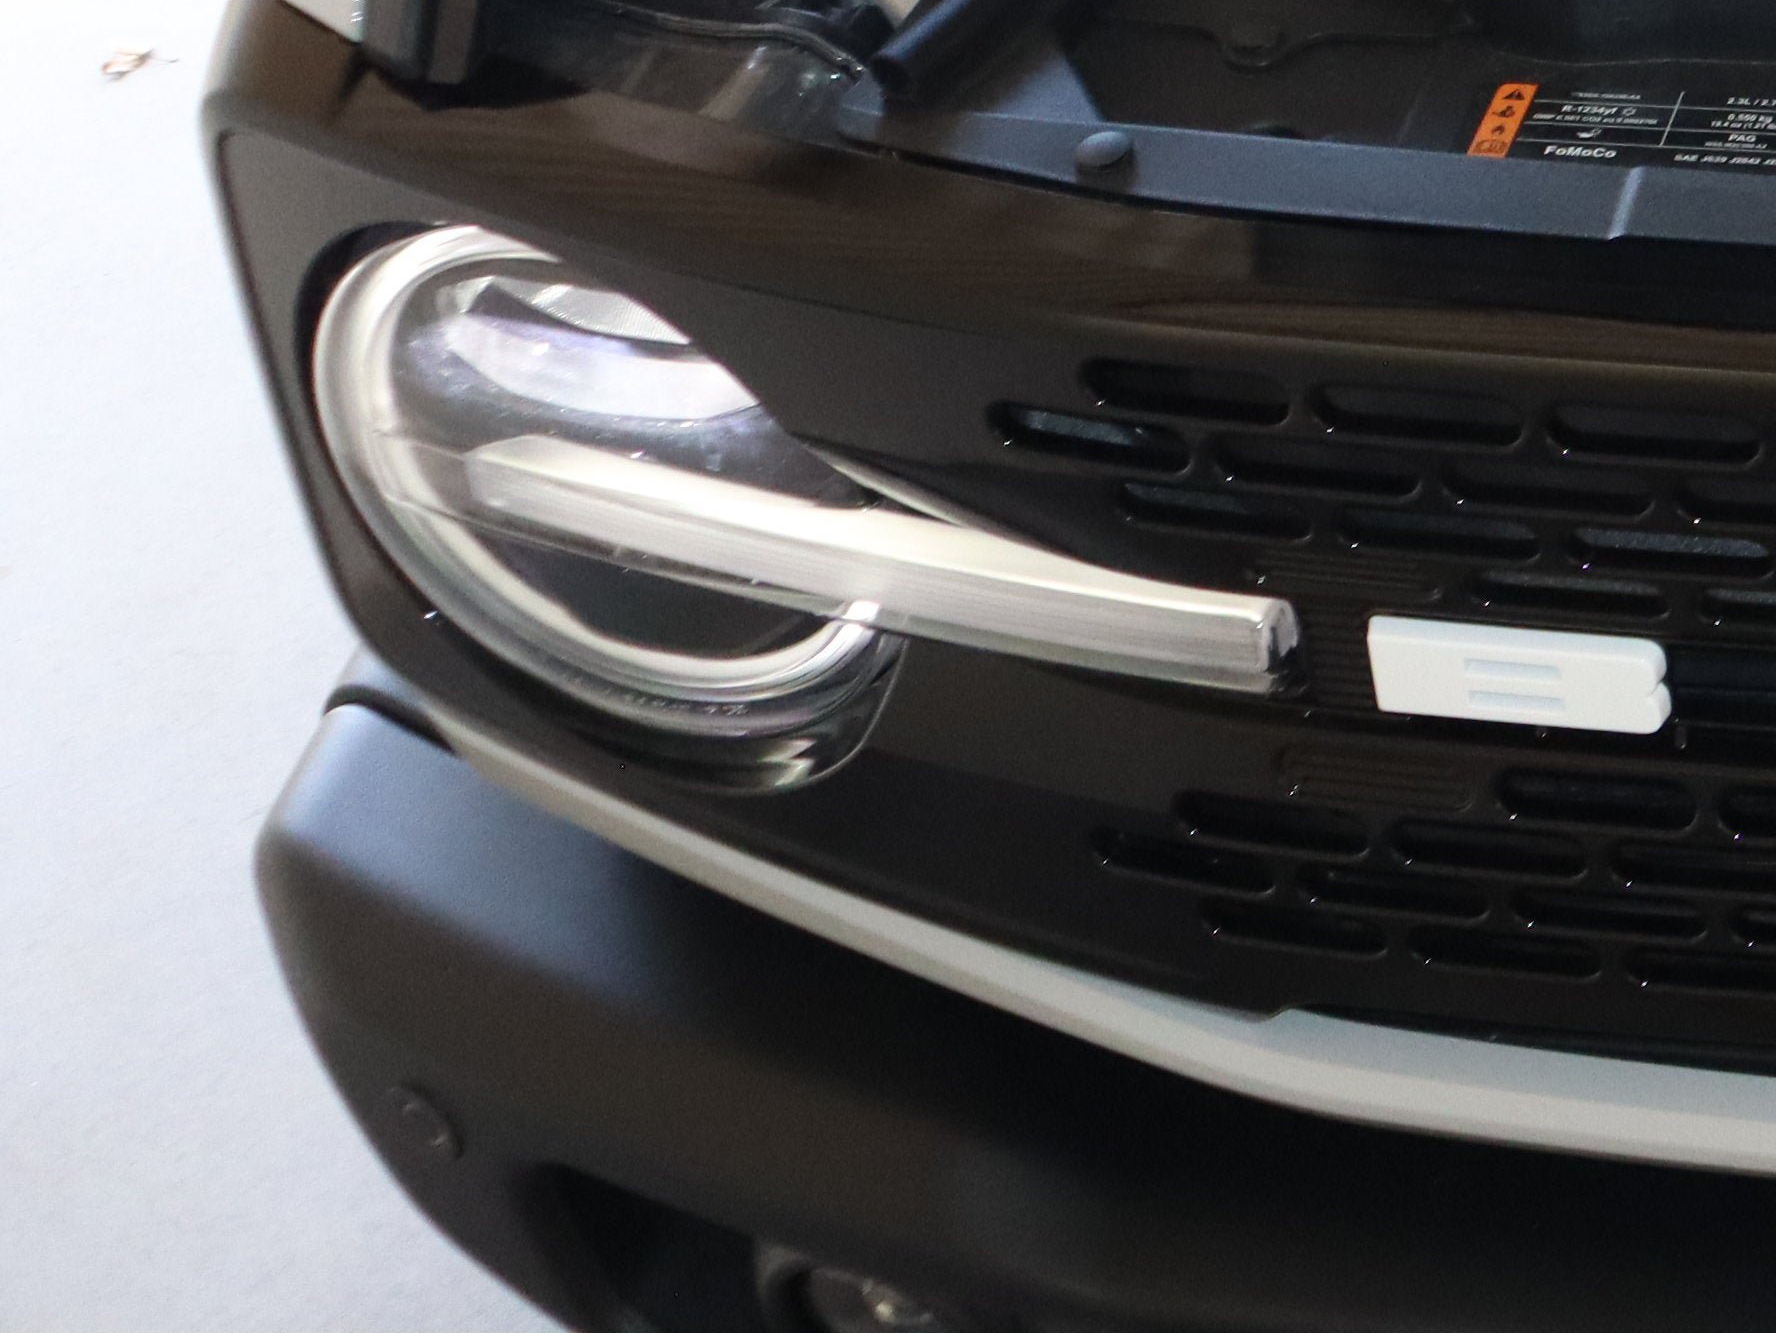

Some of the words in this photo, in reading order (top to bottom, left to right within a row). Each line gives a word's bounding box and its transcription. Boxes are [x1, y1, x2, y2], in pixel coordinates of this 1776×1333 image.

[1560, 104, 1619, 116] R-1234yf
[1727, 134, 1758, 143] PAG
[1543, 145, 1618, 159] FoMoCo
